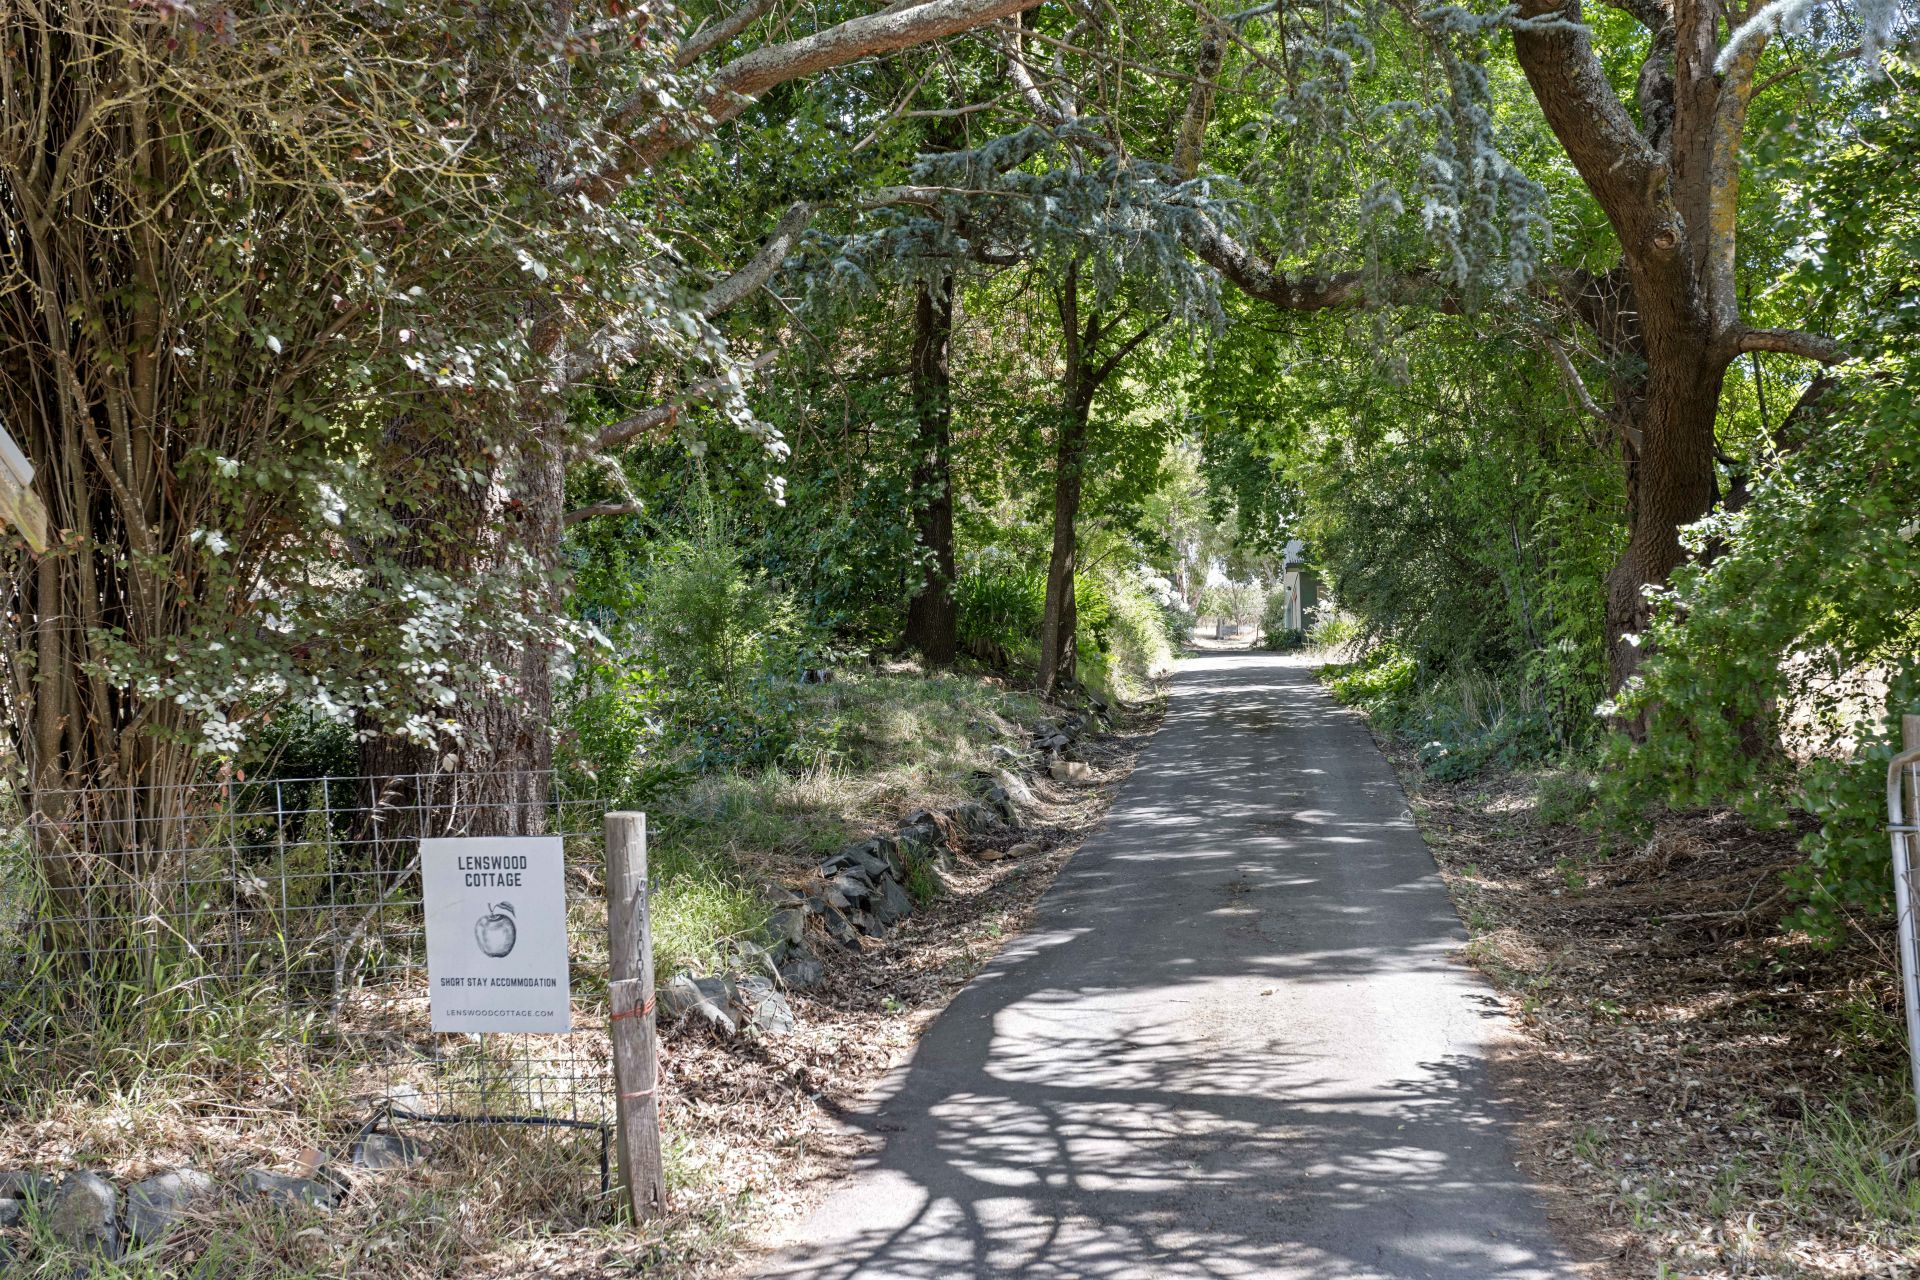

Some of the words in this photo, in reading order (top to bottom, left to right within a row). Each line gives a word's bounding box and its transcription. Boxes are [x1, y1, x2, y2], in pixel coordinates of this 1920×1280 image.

[458, 855, 527, 870] LENSWOOD
[465, 873, 522, 887] COTTAGE
[440, 977, 465, 987] SHORT
[467, 977, 488, 987] STAY
[490, 977, 557, 988] ACCOMMODATION
[446, 1009, 554, 1017] LENSWOODCOTTAGE.COM
